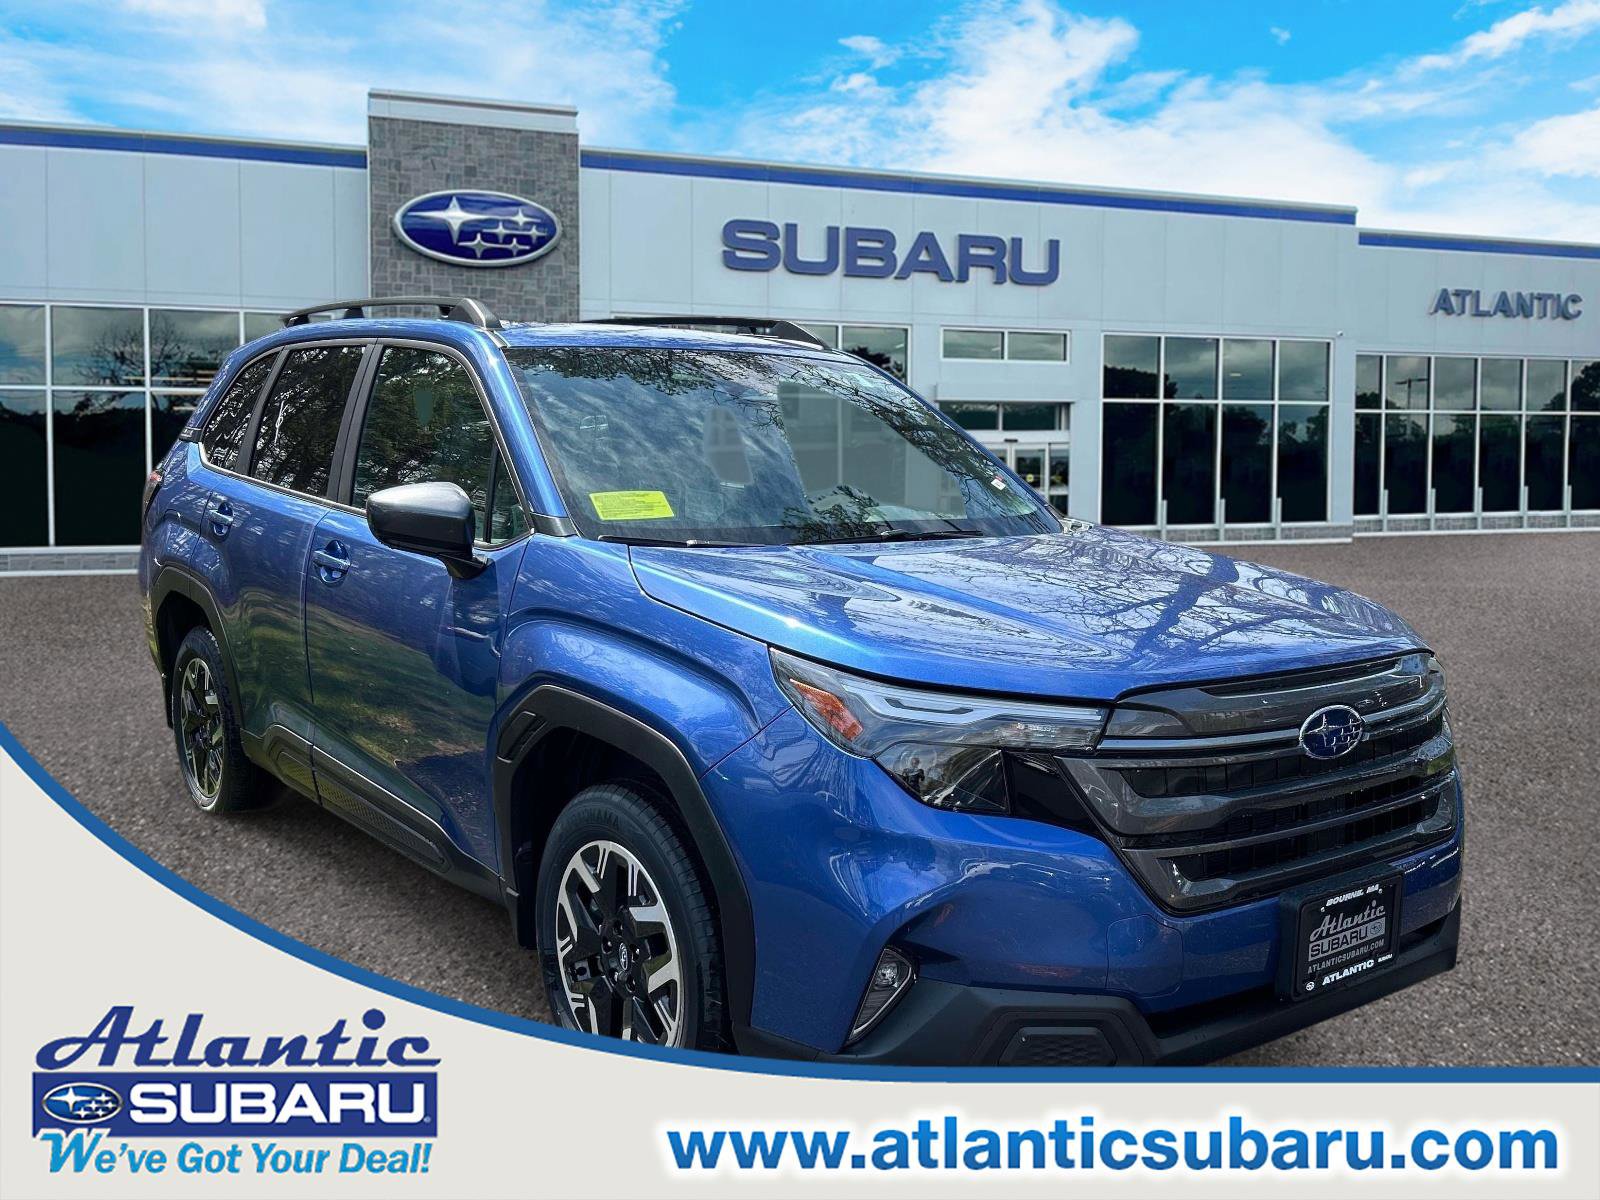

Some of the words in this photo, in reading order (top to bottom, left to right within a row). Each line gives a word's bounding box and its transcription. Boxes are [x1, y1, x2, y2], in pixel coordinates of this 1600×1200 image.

[722, 219, 1061, 286] SUBARU
[1429, 288, 1583, 321] ATLANTIC
[1309, 900, 1386, 942] Atlantic
[1307, 939, 1385, 974] ATLANTICSUBARU.COM
[1310, 924, 1368, 958] SUBARU
[1322, 959, 1375, 985] ATLANTIC
